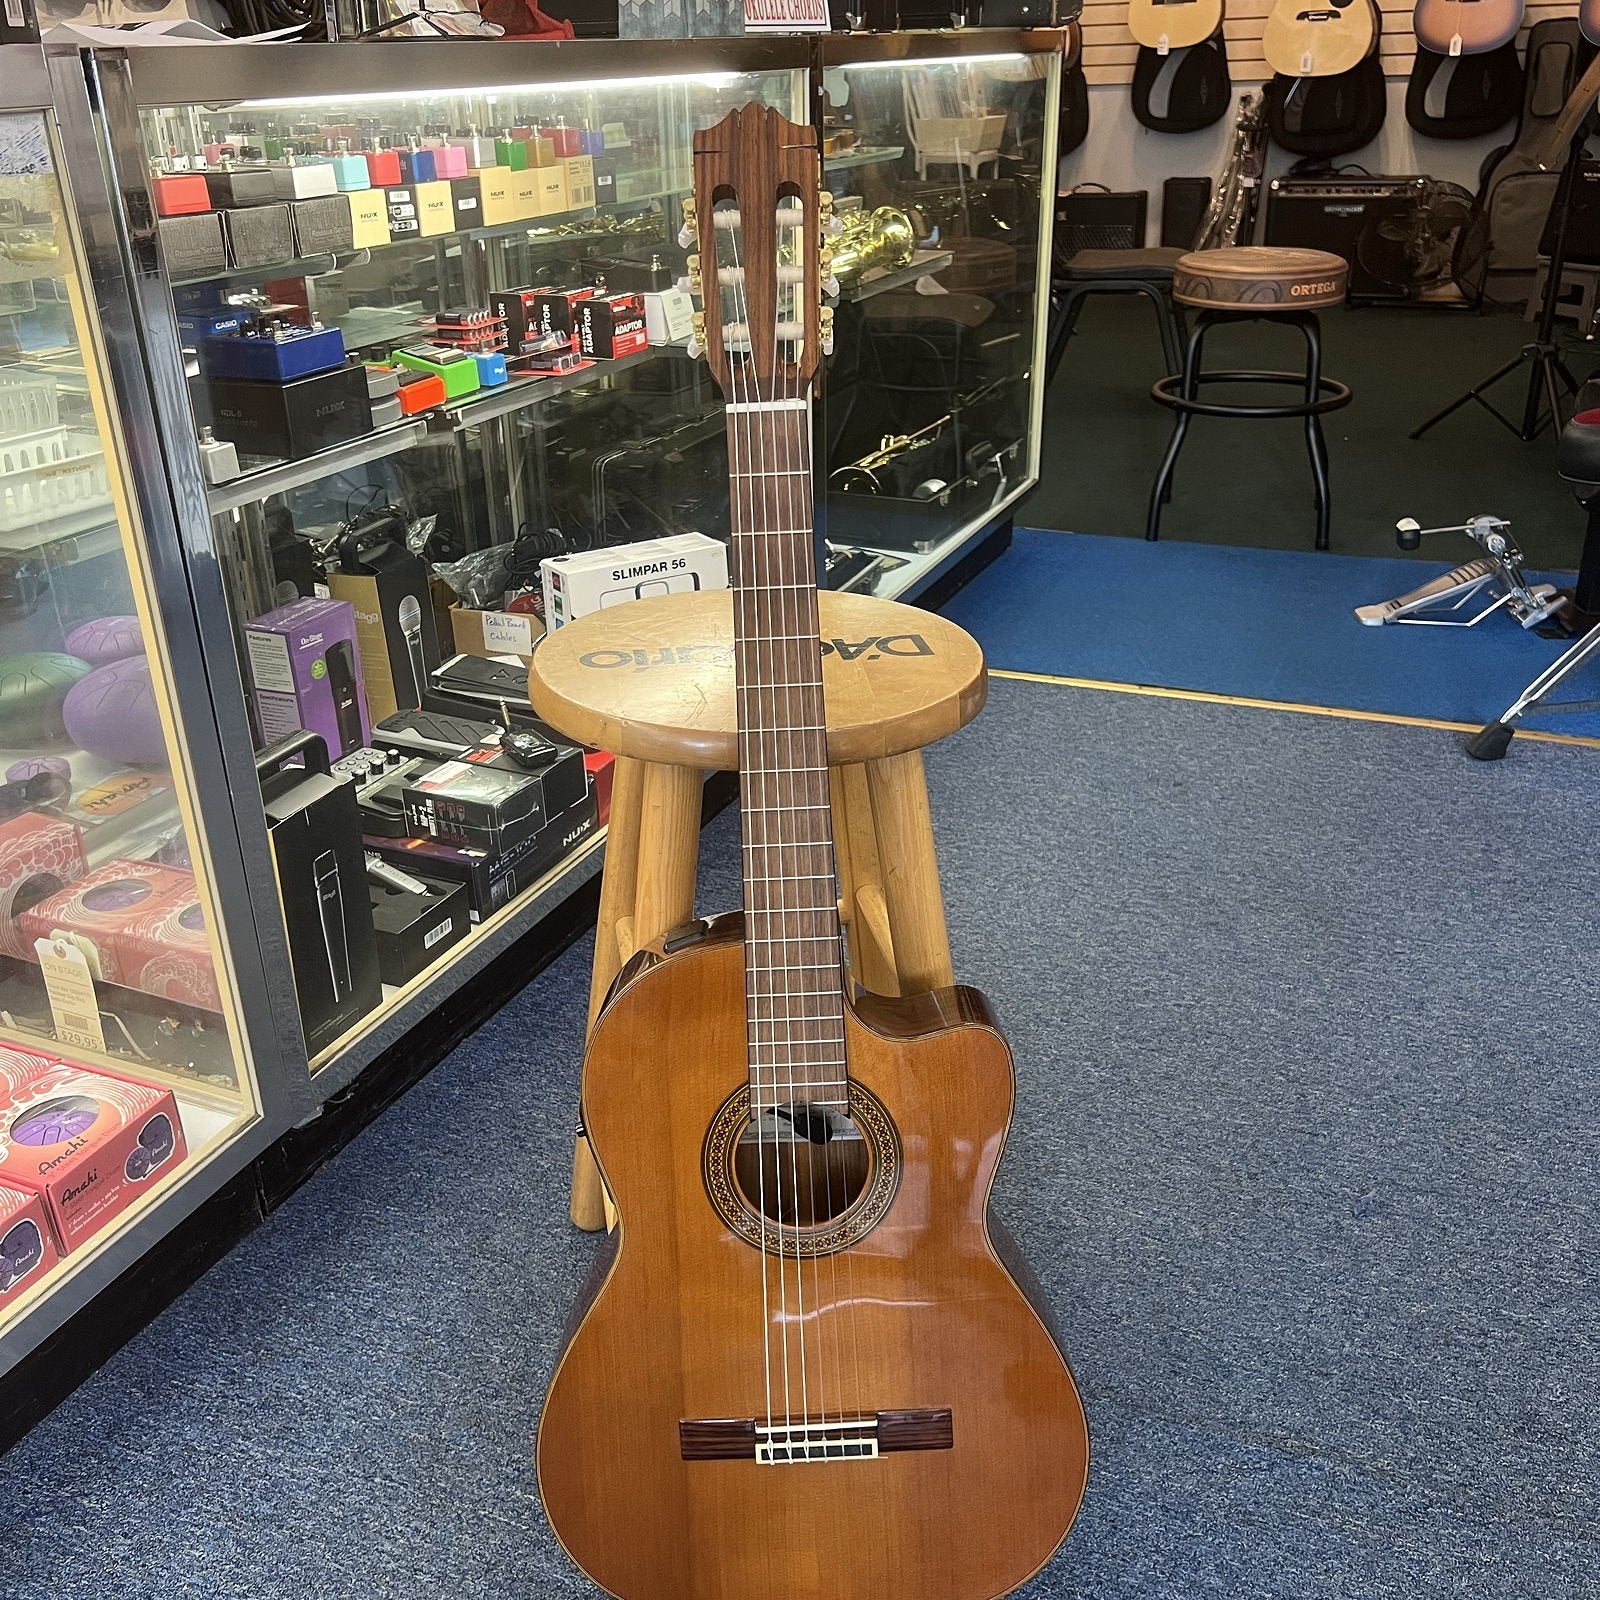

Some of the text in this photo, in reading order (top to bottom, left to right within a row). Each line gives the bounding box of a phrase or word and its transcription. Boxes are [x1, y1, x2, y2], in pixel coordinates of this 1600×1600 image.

[787, 0, 823, 20] CHORDS
[1290, 281, 1337, 297] ORTEGA
[178, 322, 194, 330] ASIO
[215, 319, 238, 330] CASIO
[585, 307, 594, 354] ADAPTOR
[614, 319, 643, 336] ADAPTOR
[612, 558, 686, 581] SLIMPAR 56
[562, 818, 592, 847] NUX
[61, 1031, 98, 1050] $29.95
[38, 1136, 89, 1175] Amahi
[61, 1168, 98, 1207] Amahi
